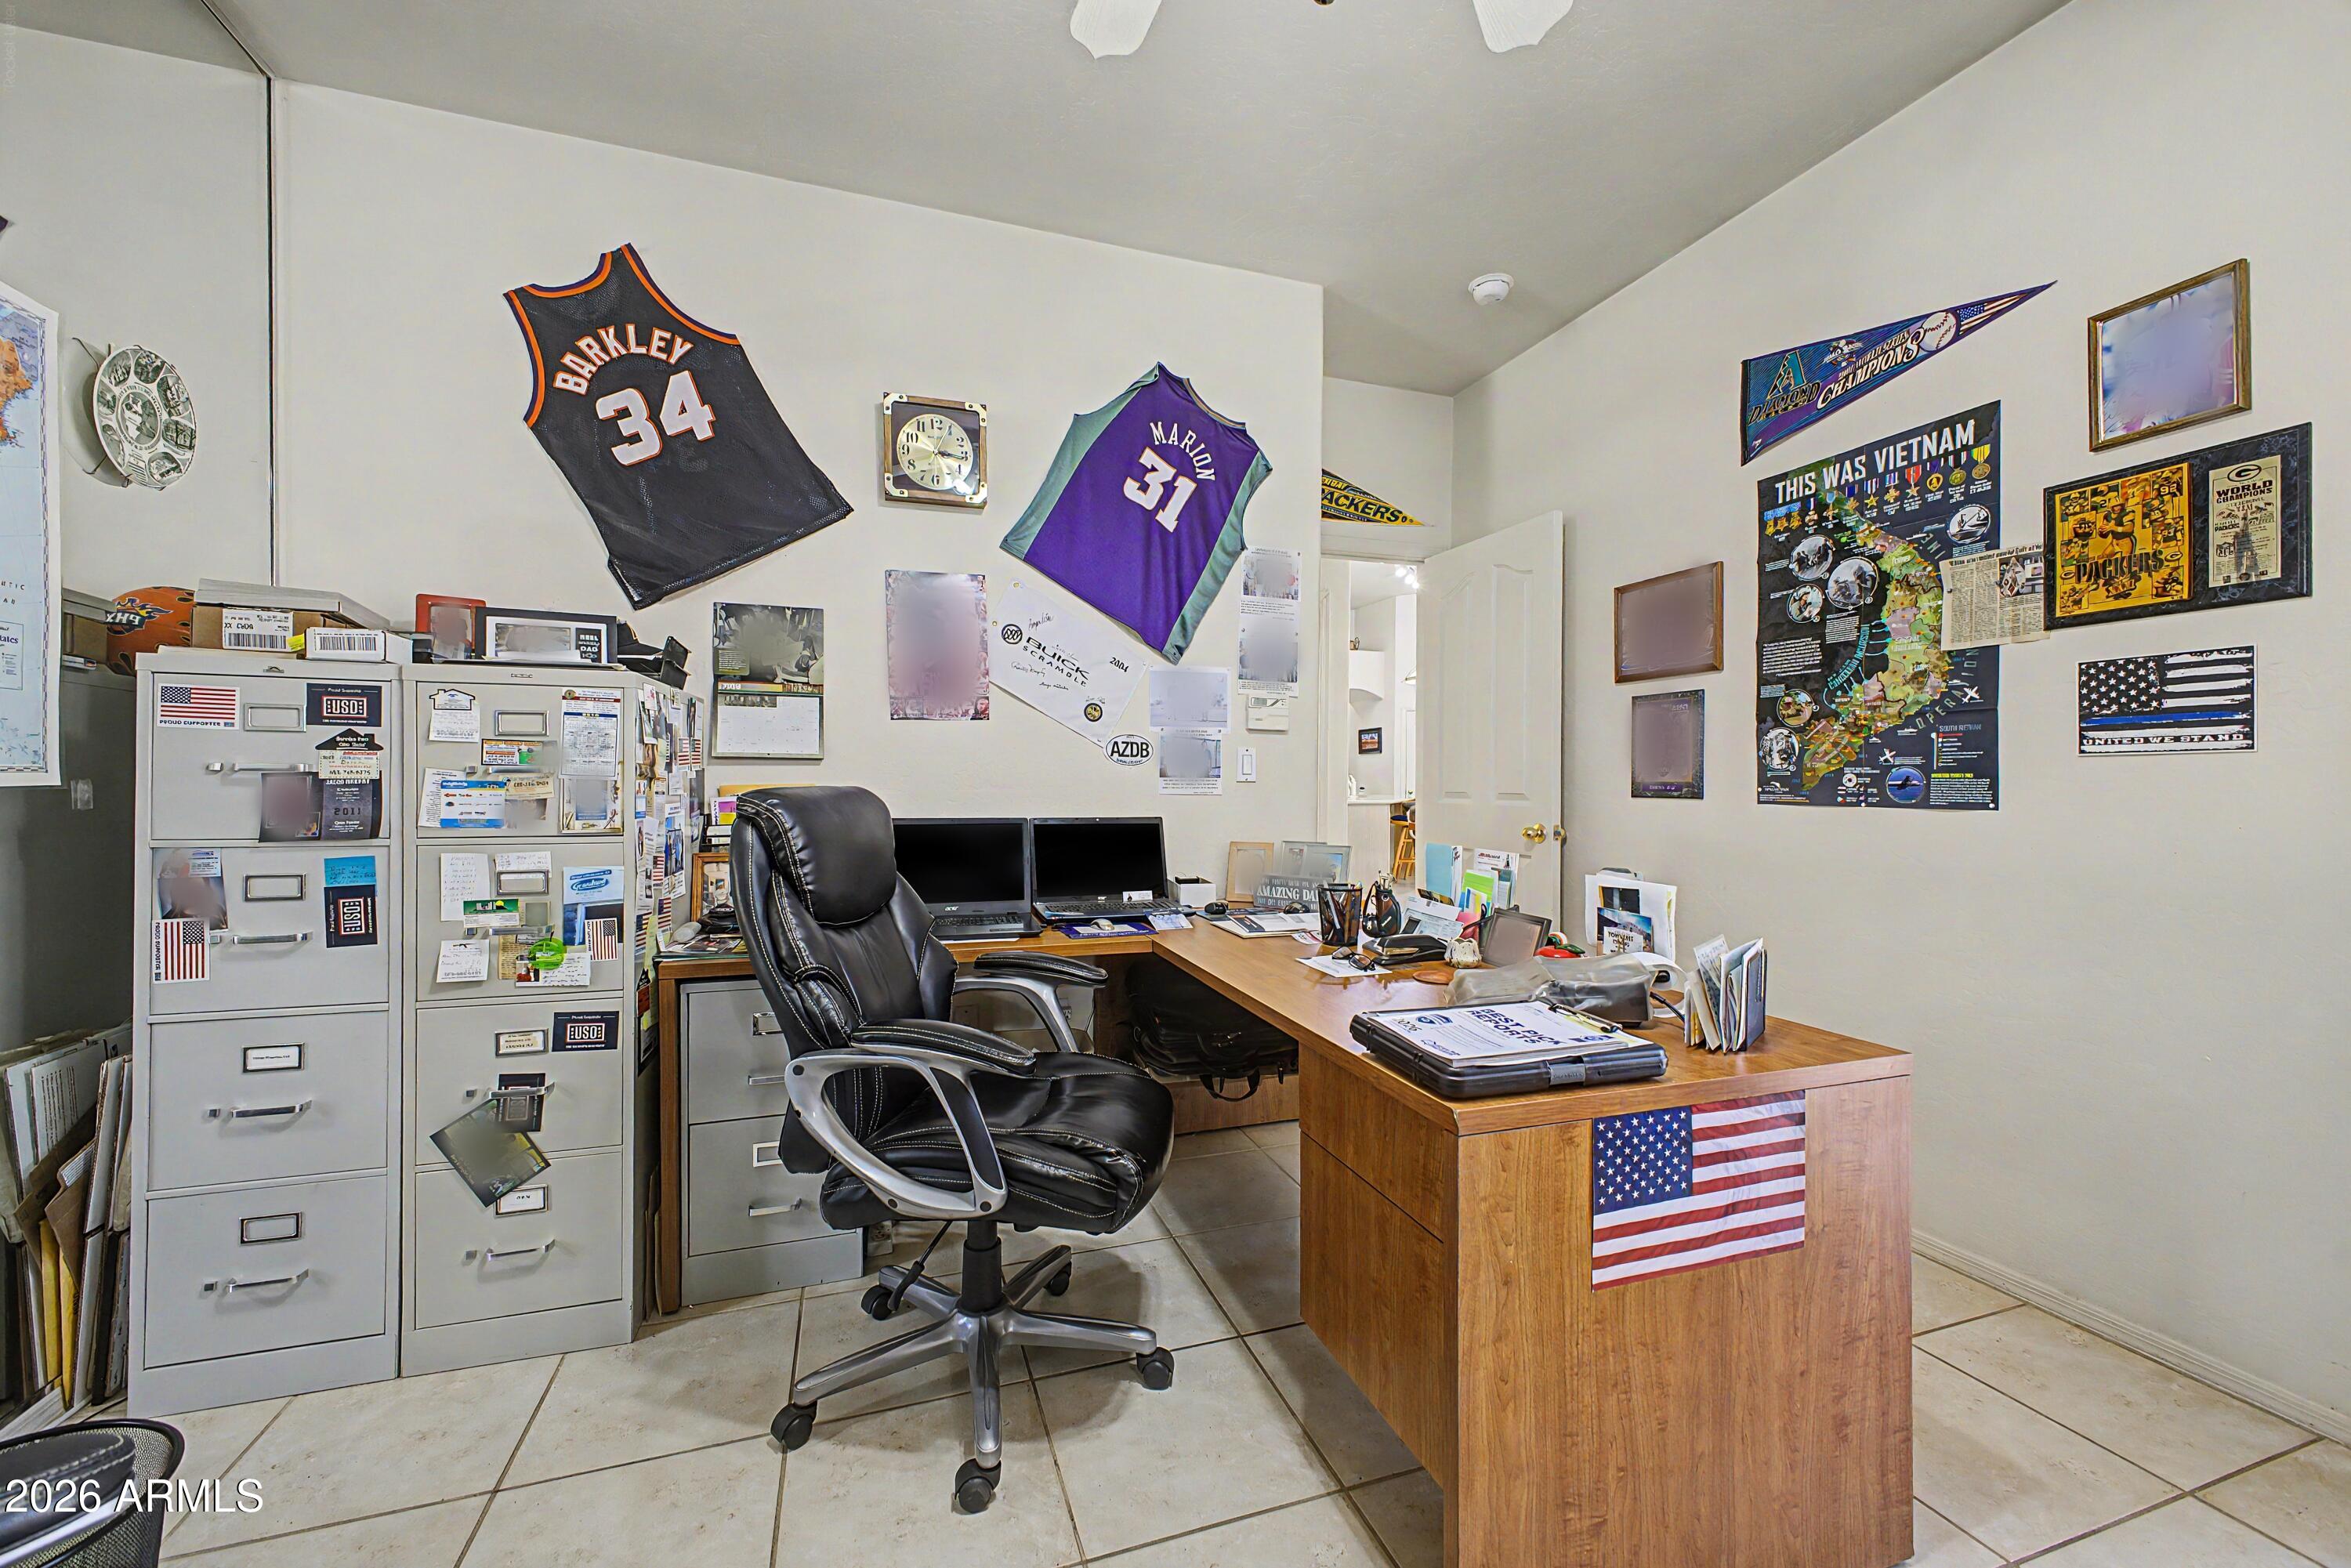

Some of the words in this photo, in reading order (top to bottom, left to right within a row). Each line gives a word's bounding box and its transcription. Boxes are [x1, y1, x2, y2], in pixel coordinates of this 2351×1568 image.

[553, 323, 694, 396] BARKLEY
[1817, 327, 1925, 411] CHAMPIONS
[595, 370, 717, 466] 34
[1748, 381, 1822, 426] DIAMOND
[1149, 421, 1215, 481] MARION
[1775, 473, 1817, 505] THIS
[1822, 455, 1866, 490] WAS
[1875, 419, 1976, 473] VIETNAM
[1123, 446, 1197, 534] 31
[2161, 483, 2178, 495] 92
[2216, 480, 2273, 498] WORLD
[2216, 487, 2273, 504] CHAMPIONS
[2075, 550, 2164, 585] PACKERS
[1022, 645, 1087, 687] SCRAMBLE
[1027, 636, 1090, 682] BUICK
[331, 700, 358, 714] USO
[1110, 741, 1150, 759] AZDB
[2083, 737, 2144, 746] UNITED
[2148, 736, 2175, 744] WE
[2180, 733, 2244, 744] STAND
[1256, 885, 1299, 900] AMAZING
[343, 906, 361, 928] USO
[574, 1025, 599, 1040] USO
[1466, 1010, 1541, 1044] REPORTS
[1479, 1009, 1523, 1027] BEST
[1522, 1030, 1567, 1045] PICK
